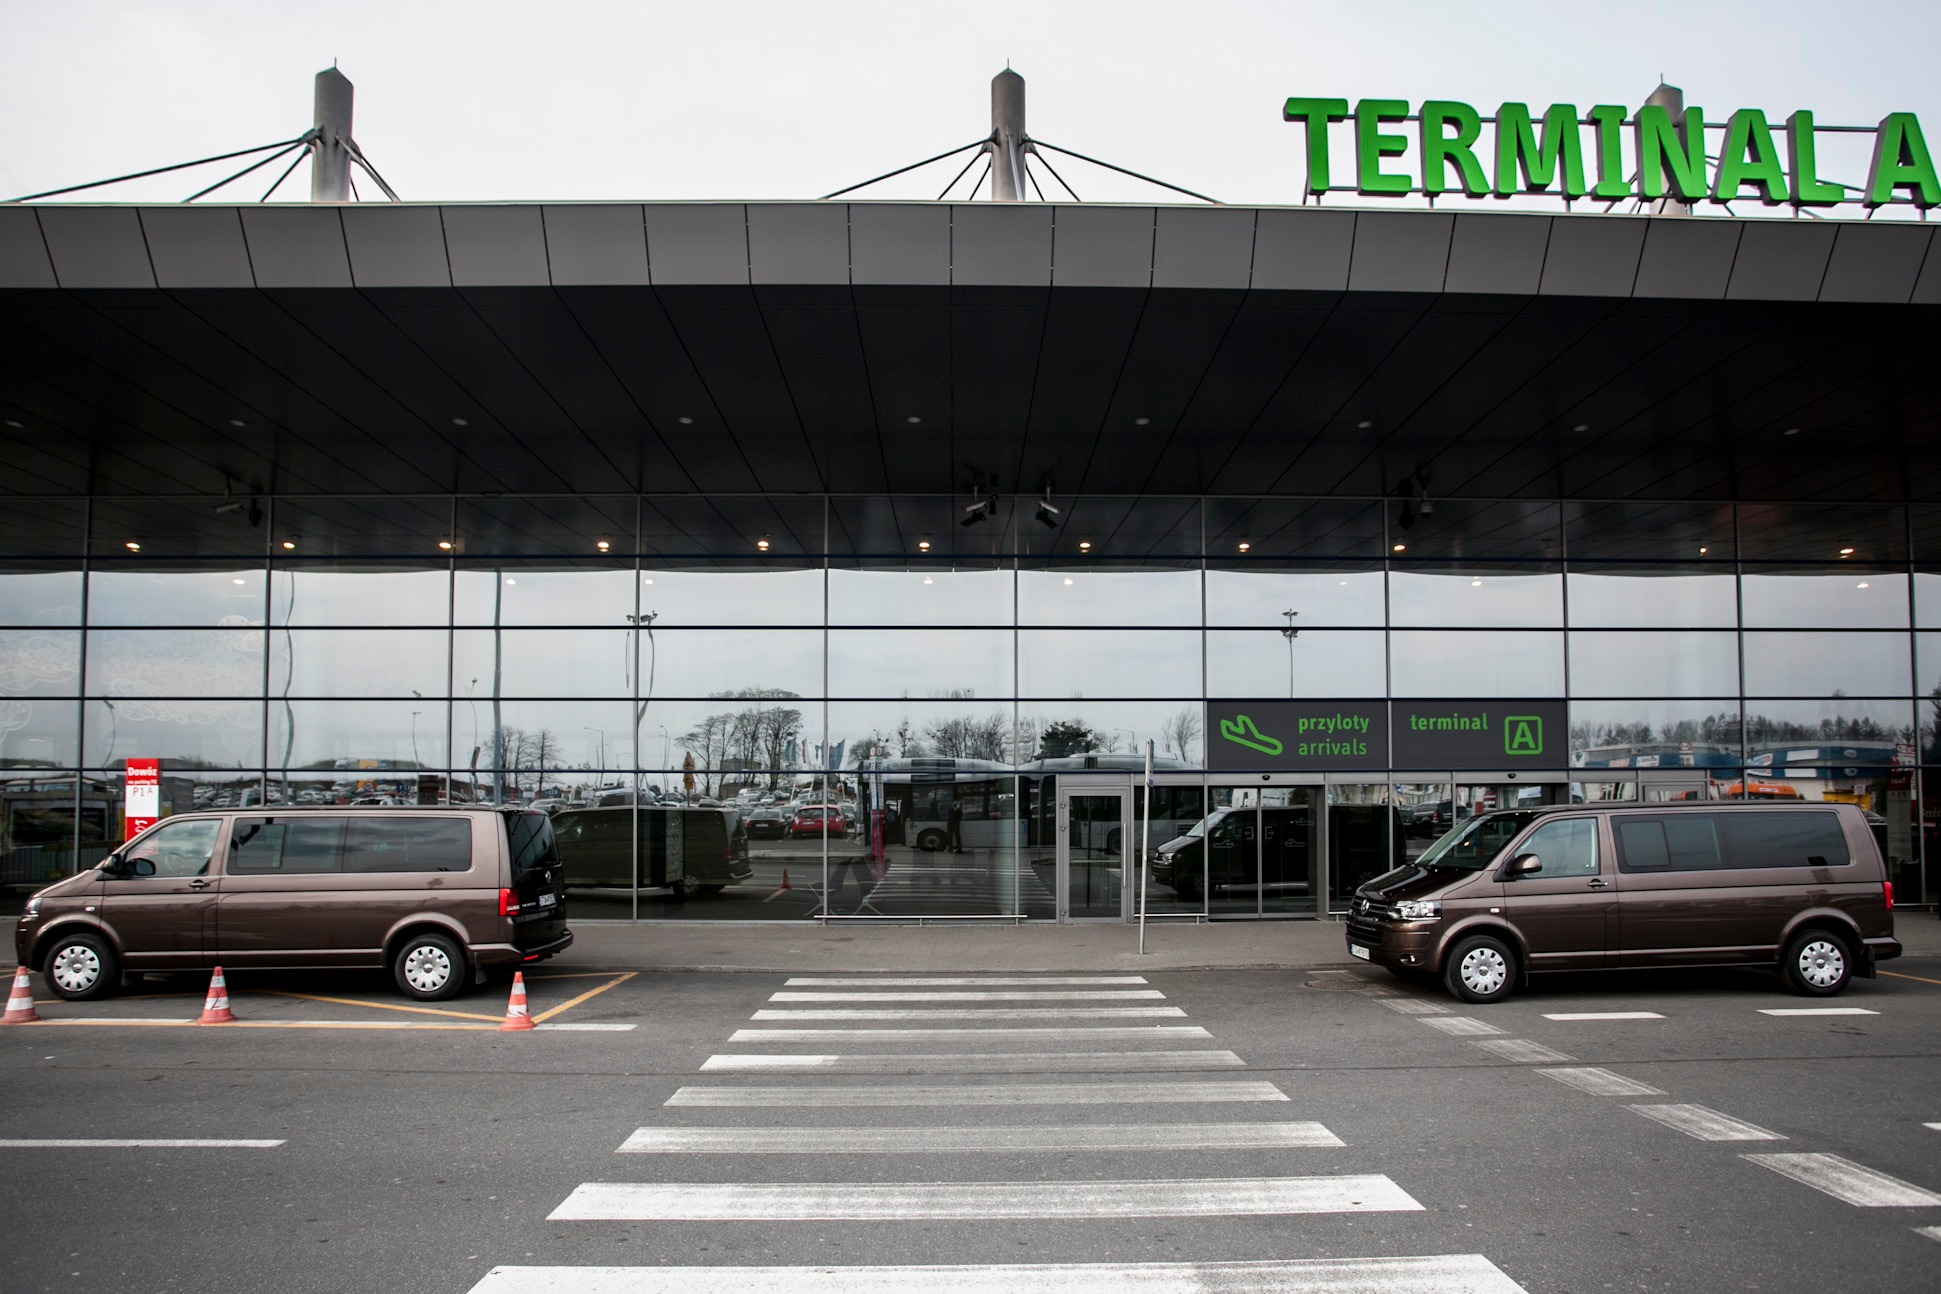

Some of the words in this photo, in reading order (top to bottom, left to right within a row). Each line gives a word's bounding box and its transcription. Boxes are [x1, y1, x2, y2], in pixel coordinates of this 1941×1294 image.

[1283, 97, 1844, 206] TERMINAL
[1865, 111, 1941, 207] A
[1299, 713, 1369, 734] przyloty
[1410, 713, 1488, 731] terminal
[1512, 721, 1536, 749] A
[1299, 737, 1367, 756] arrivals
[127, 766, 157, 776] Dowóz
